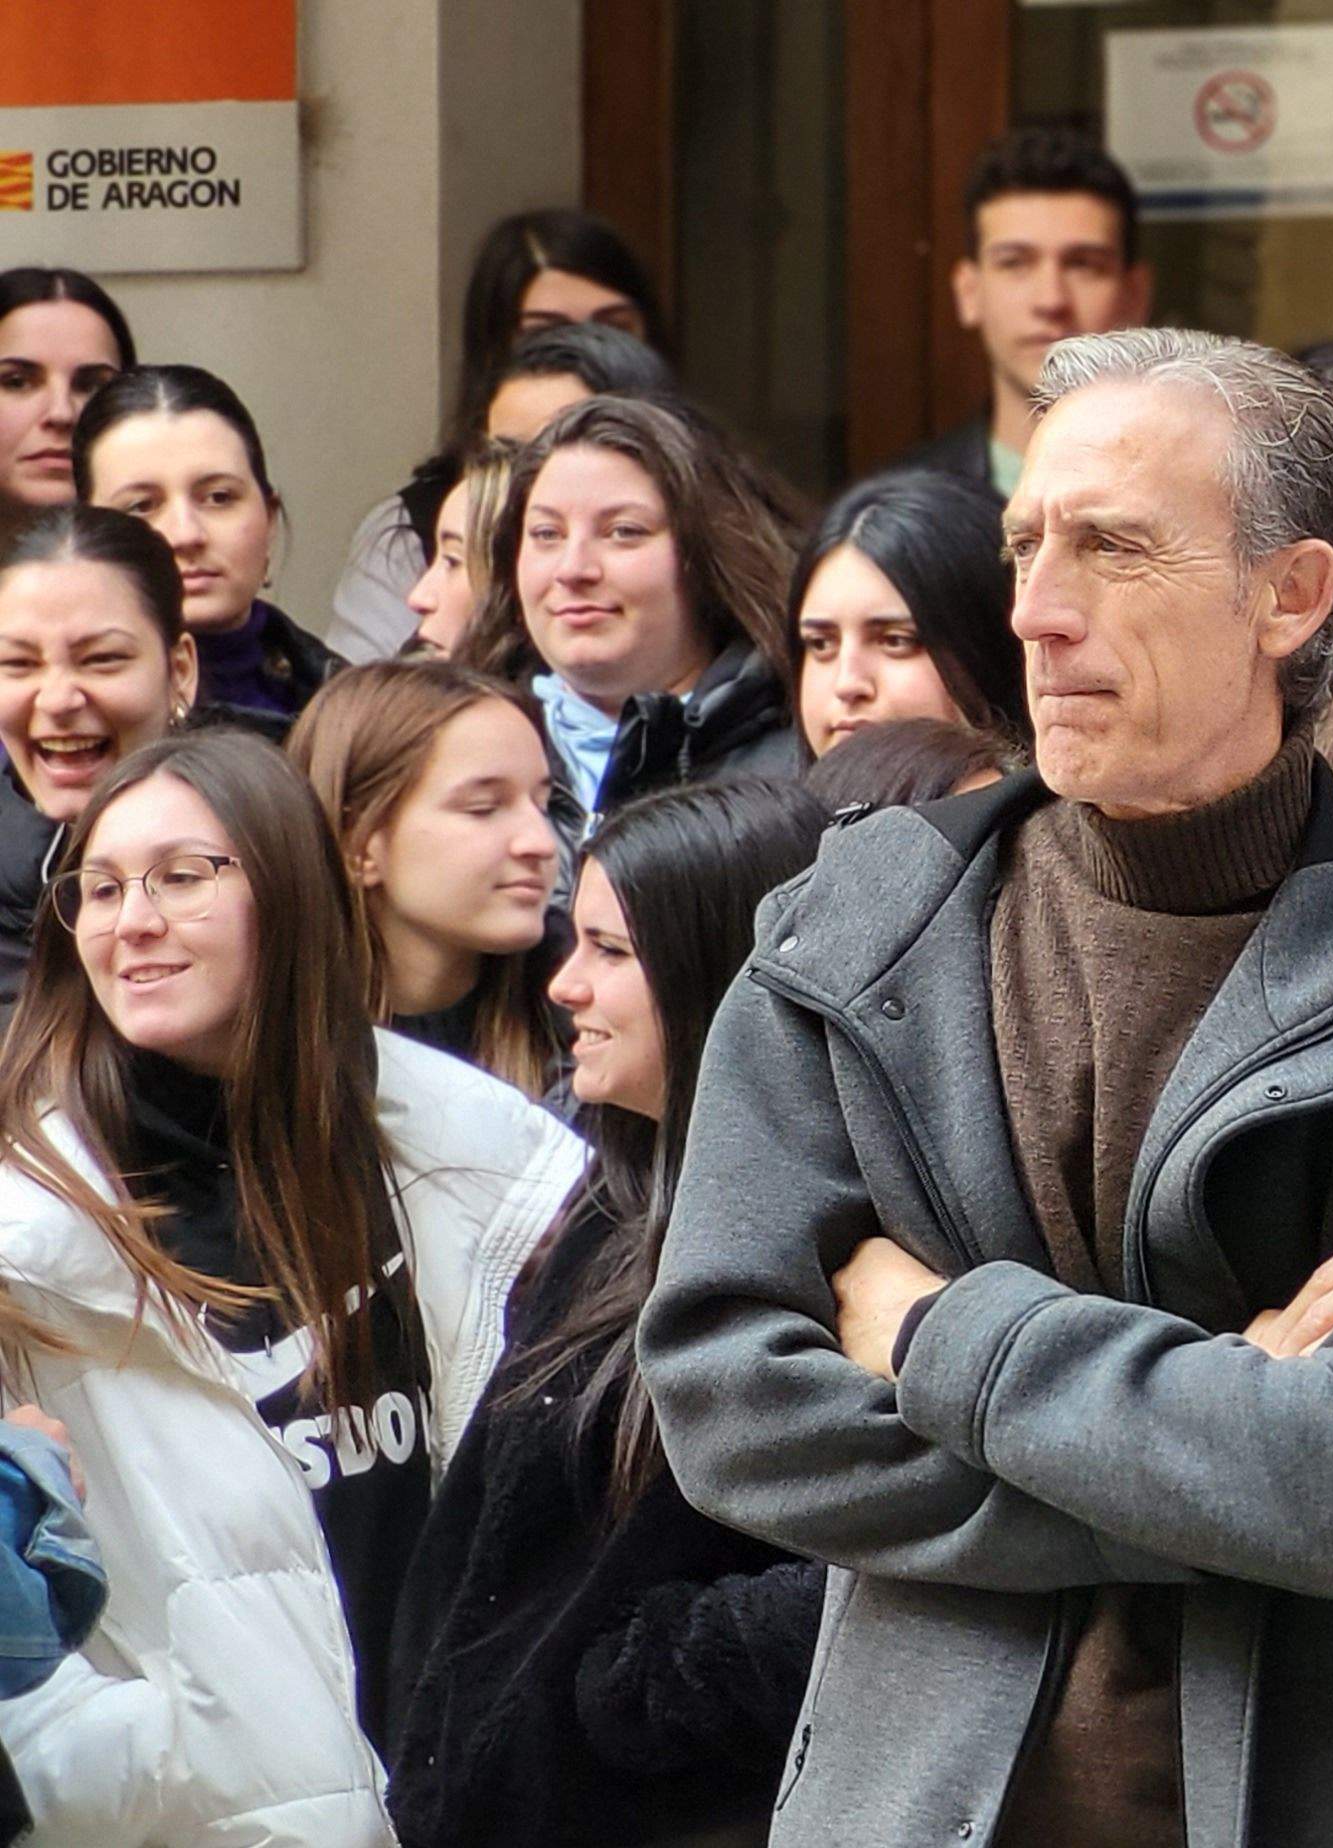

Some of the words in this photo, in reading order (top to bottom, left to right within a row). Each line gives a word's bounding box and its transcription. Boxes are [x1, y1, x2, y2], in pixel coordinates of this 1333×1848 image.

[47, 146, 217, 178] GOBIERNO
[47, 183, 90, 212] DE
[101, 178, 241, 210] ARAGON
